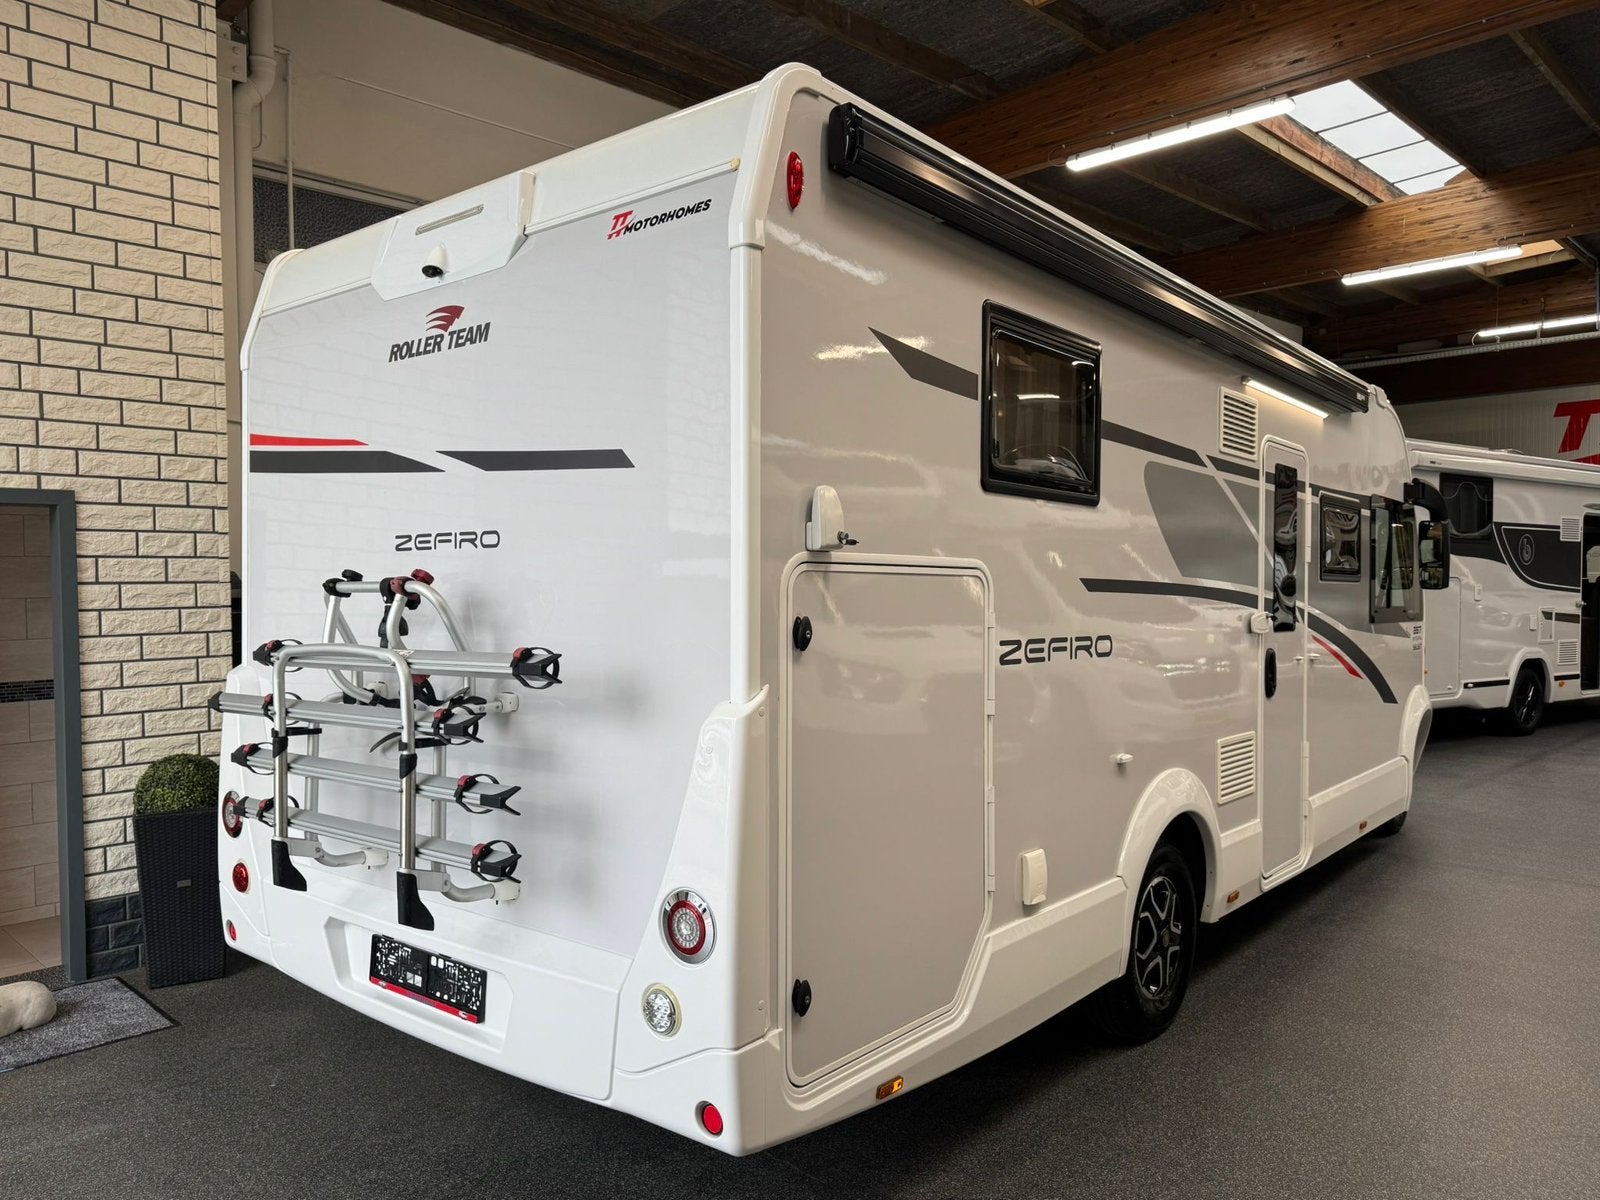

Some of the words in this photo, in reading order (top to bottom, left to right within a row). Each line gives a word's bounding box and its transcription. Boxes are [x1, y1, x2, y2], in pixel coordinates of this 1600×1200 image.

[623, 199, 712, 235] MOTORHOMES
[388, 333, 445, 363] ROLLER
[447, 321, 491, 350] TEAM
[395, 530, 501, 552] ZEFIRO
[999, 635, 1113, 666] ZEFIRO
